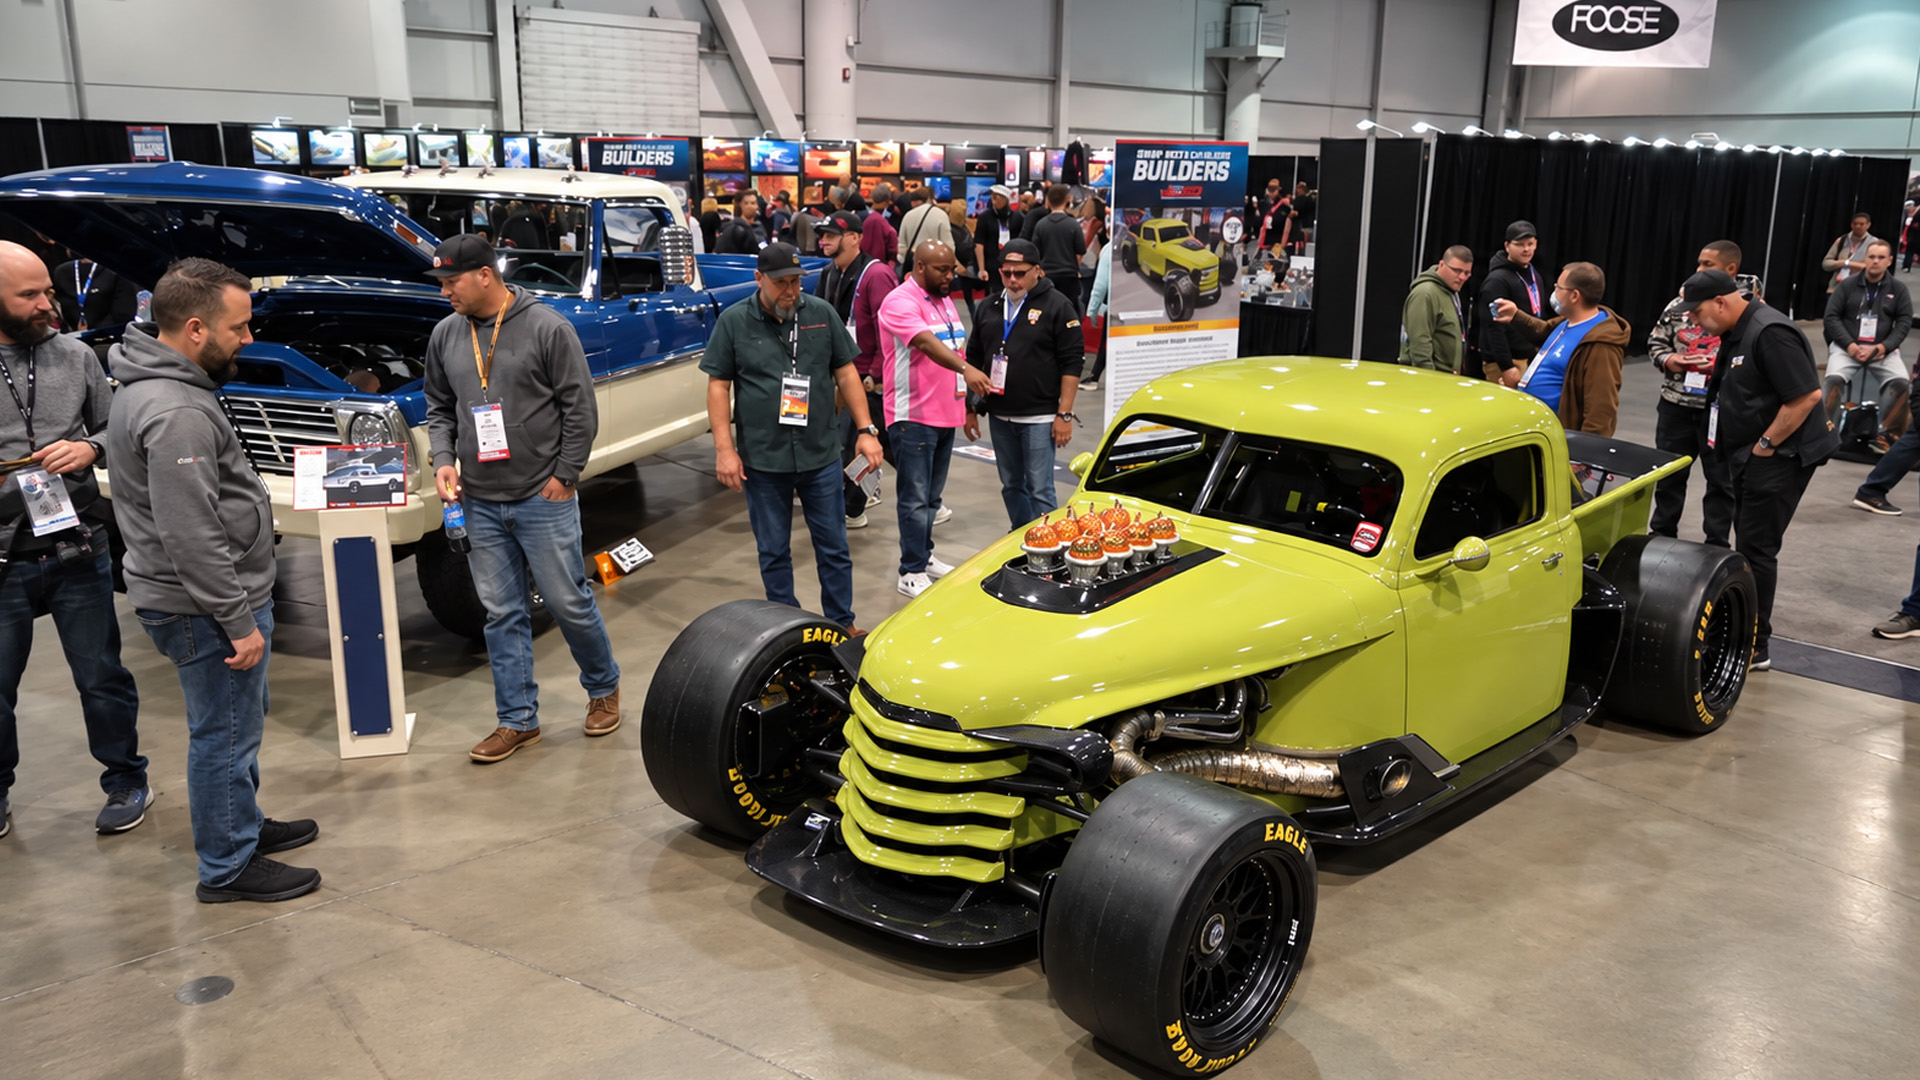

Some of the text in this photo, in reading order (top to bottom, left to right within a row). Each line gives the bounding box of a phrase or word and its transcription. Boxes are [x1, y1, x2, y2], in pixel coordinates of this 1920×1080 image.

[1570, 4, 1662, 34] FOOSE
[601, 150, 674, 166] BUILDERS
[1132, 159, 1231, 182] BUILDERS
[1264, 822, 1307, 855] EAGLE
